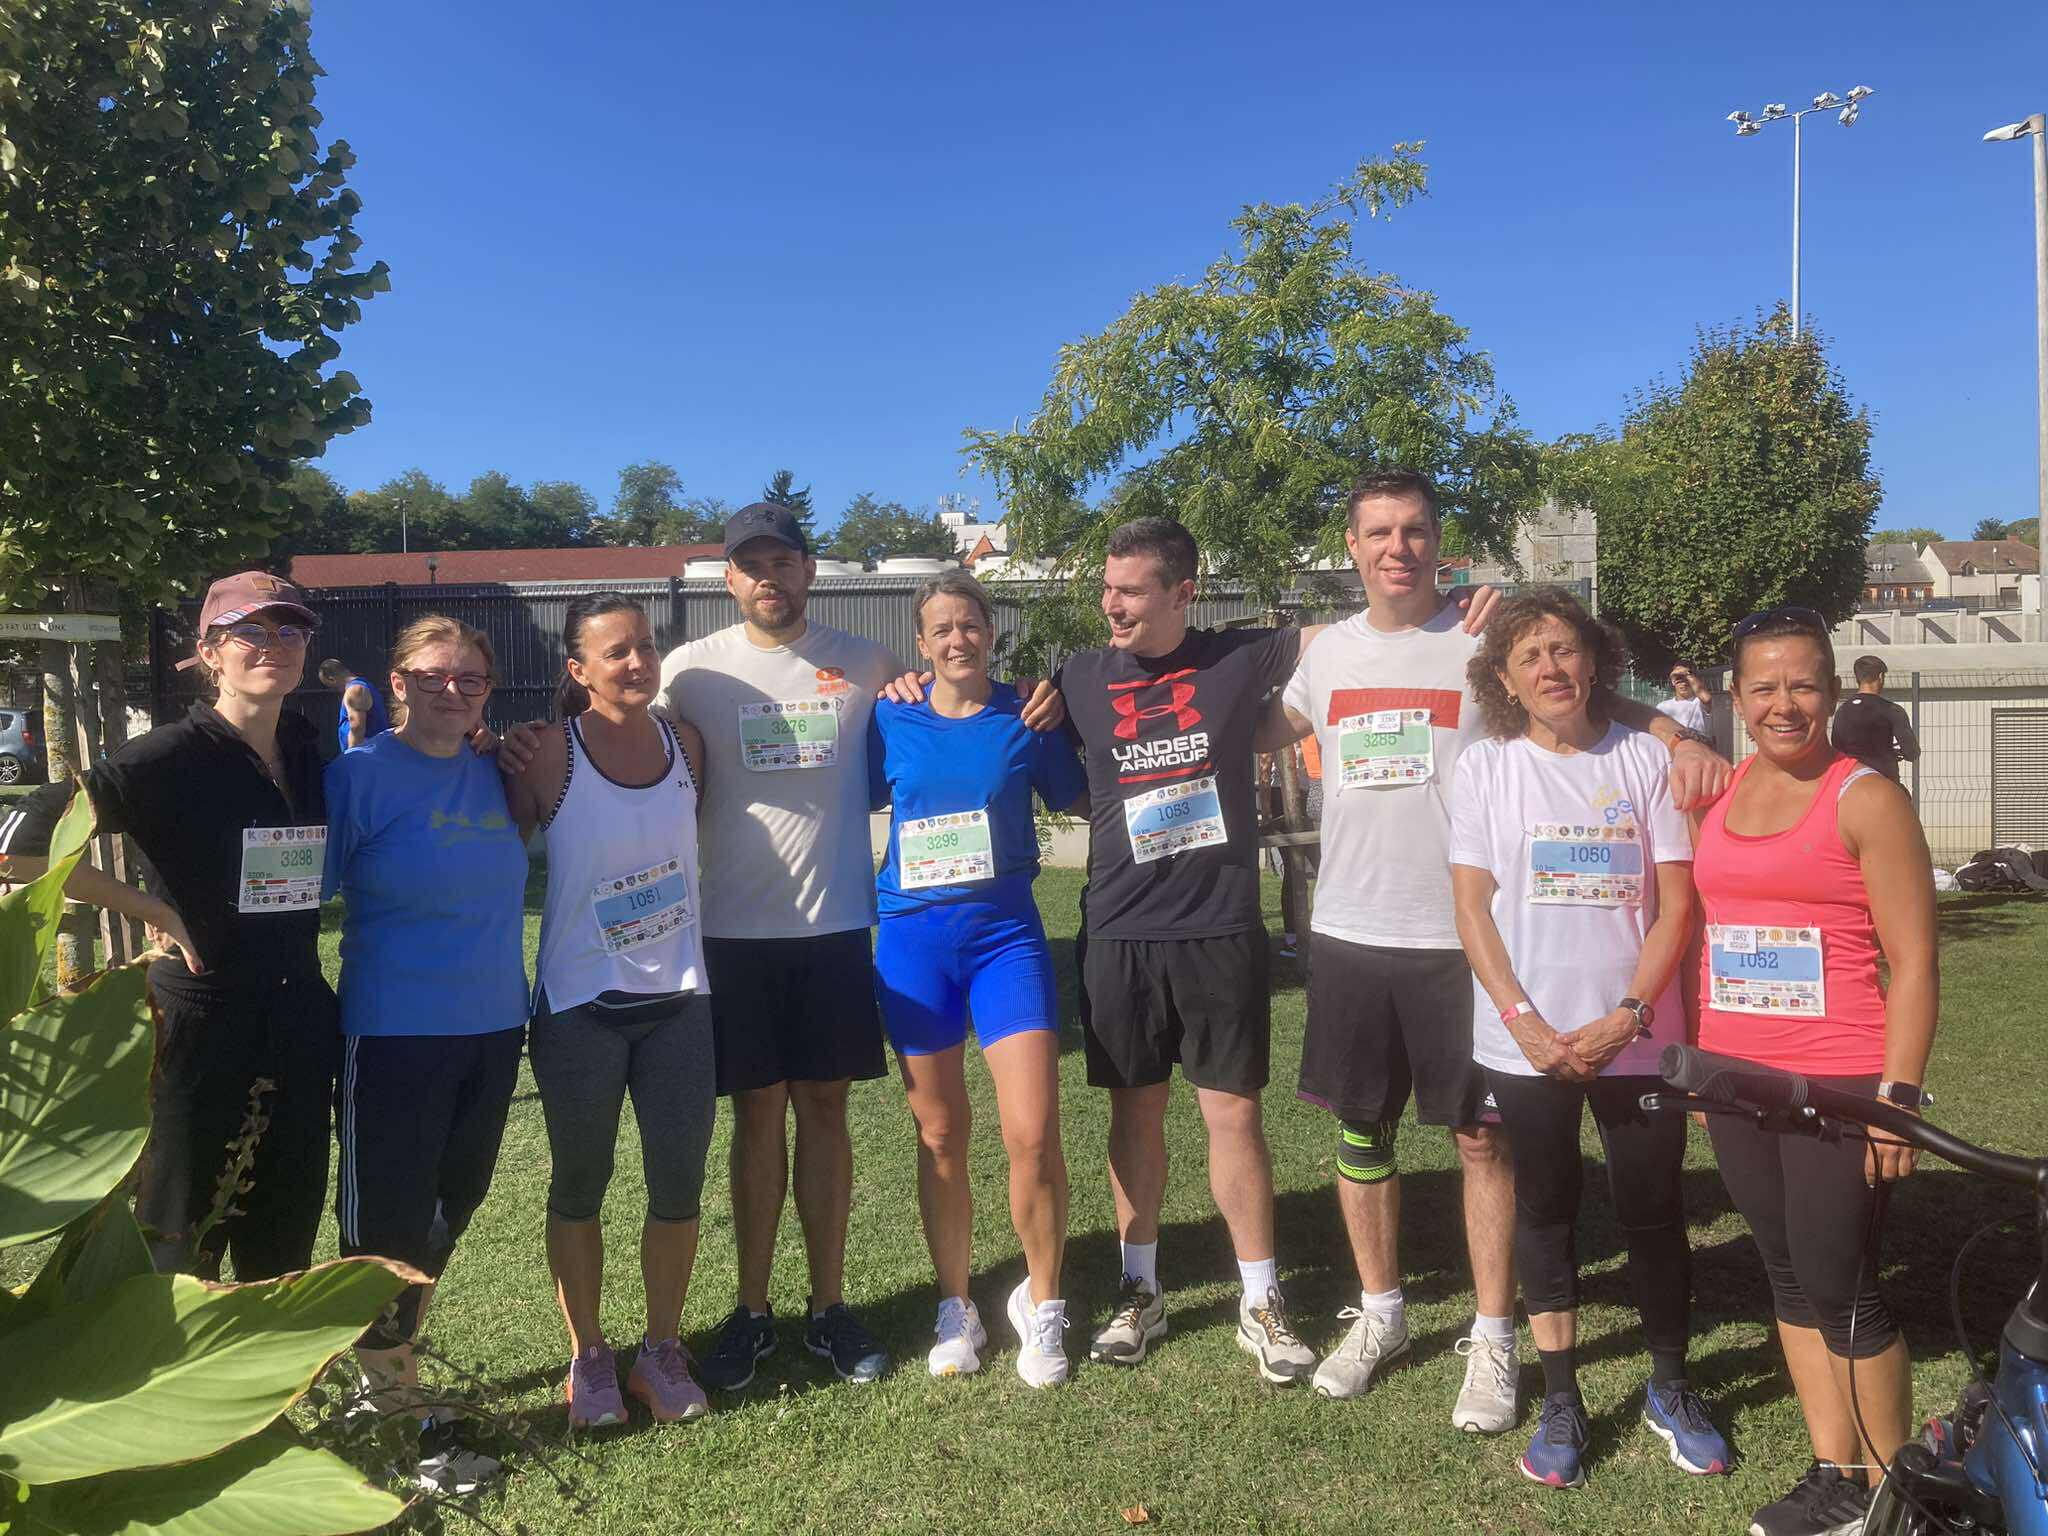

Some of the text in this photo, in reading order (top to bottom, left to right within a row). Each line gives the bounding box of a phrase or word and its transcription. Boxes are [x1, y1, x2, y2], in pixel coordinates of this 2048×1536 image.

[771, 719, 807, 735] 3276
[1112, 732, 1209, 761] UNDER
[1120, 748, 1208, 772] ARMOUR
[1157, 801, 1190, 822] 1053
[927, 832, 959, 850] 3299
[281, 848, 313, 868] 3298
[1569, 846, 1611, 863] 1050
[1535, 864, 1544, 872] 10
[627, 887, 662, 911] 1051
[1739, 952, 1779, 969] 1052
